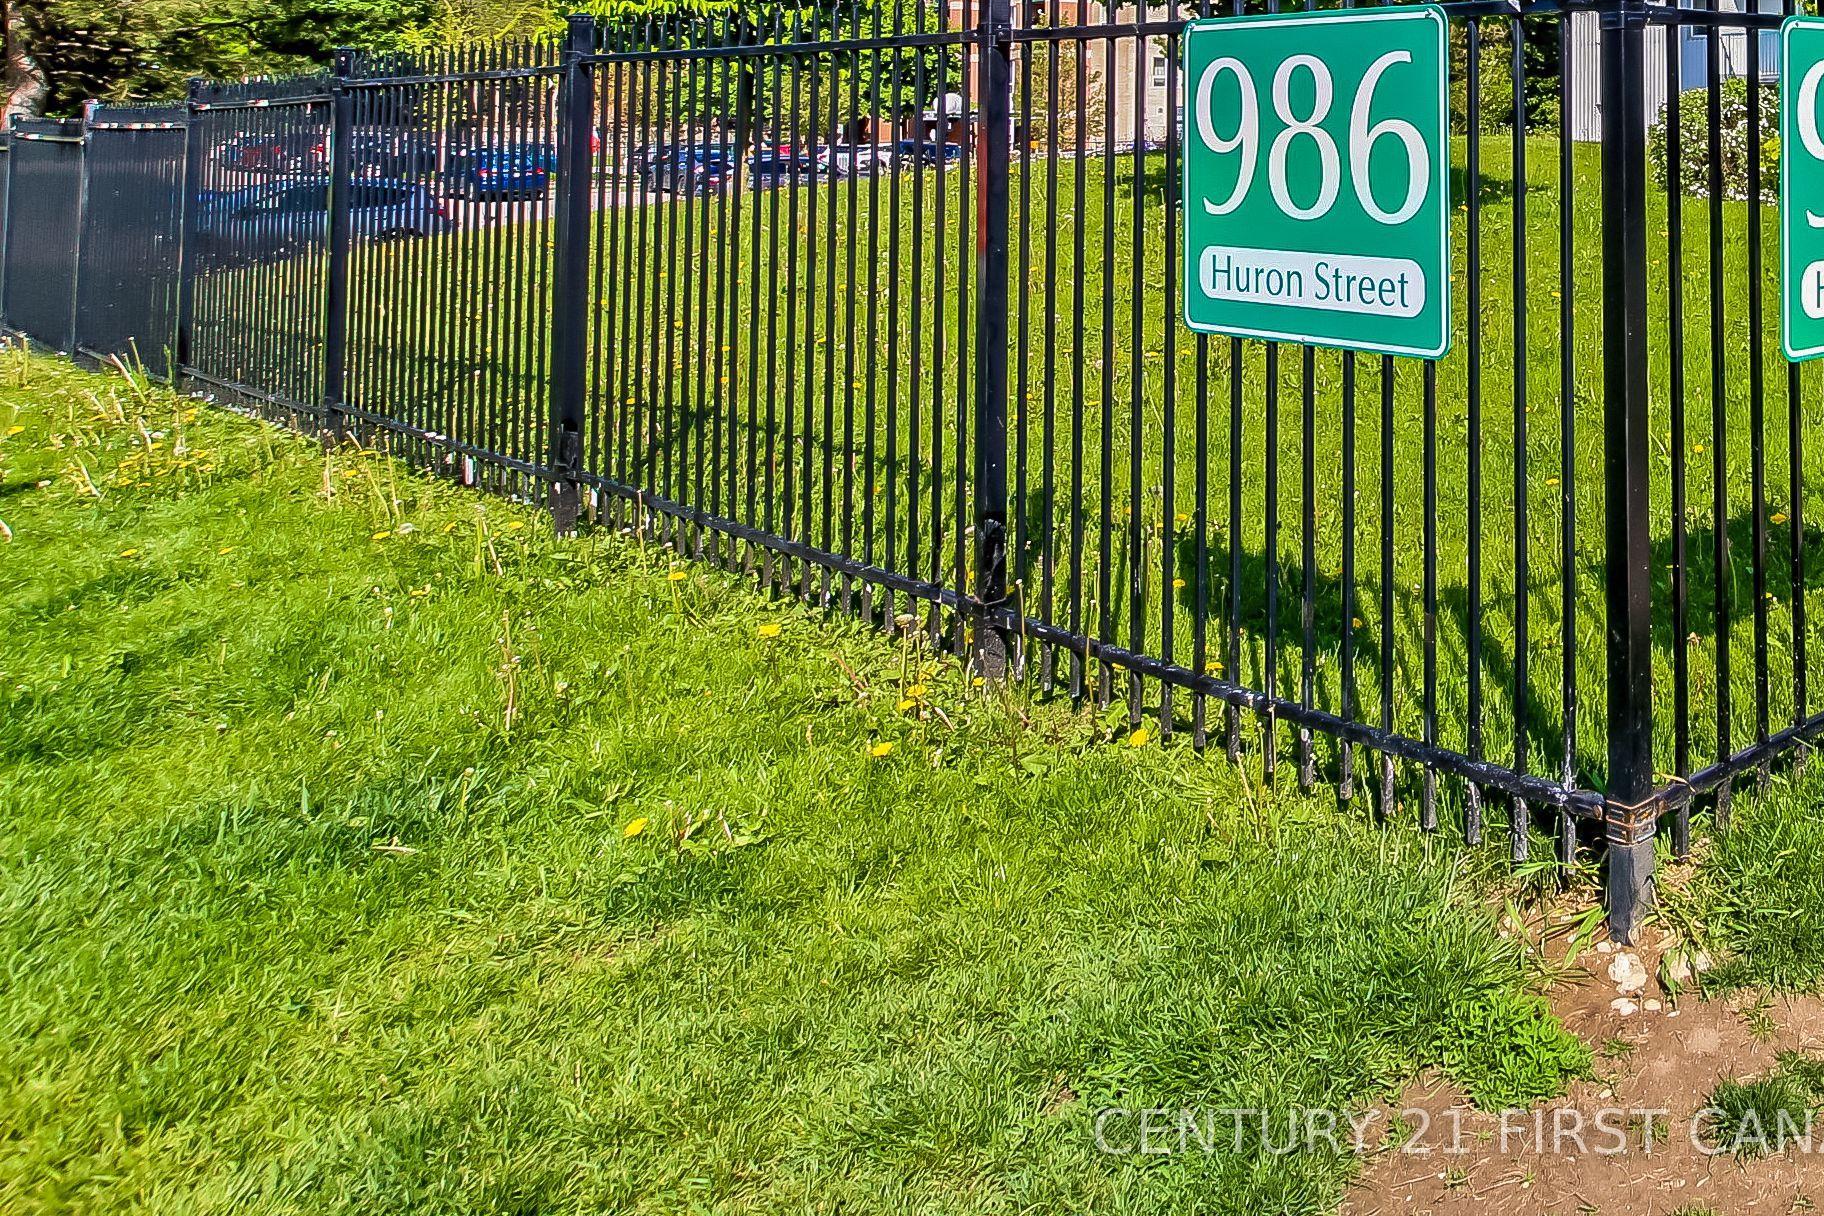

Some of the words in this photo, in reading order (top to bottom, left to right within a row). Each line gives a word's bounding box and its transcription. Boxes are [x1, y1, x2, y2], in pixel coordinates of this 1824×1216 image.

[1195, 50, 1430, 225] 986
[1211, 254, 1303, 298] Huron
[1314, 261, 1409, 308] Street
